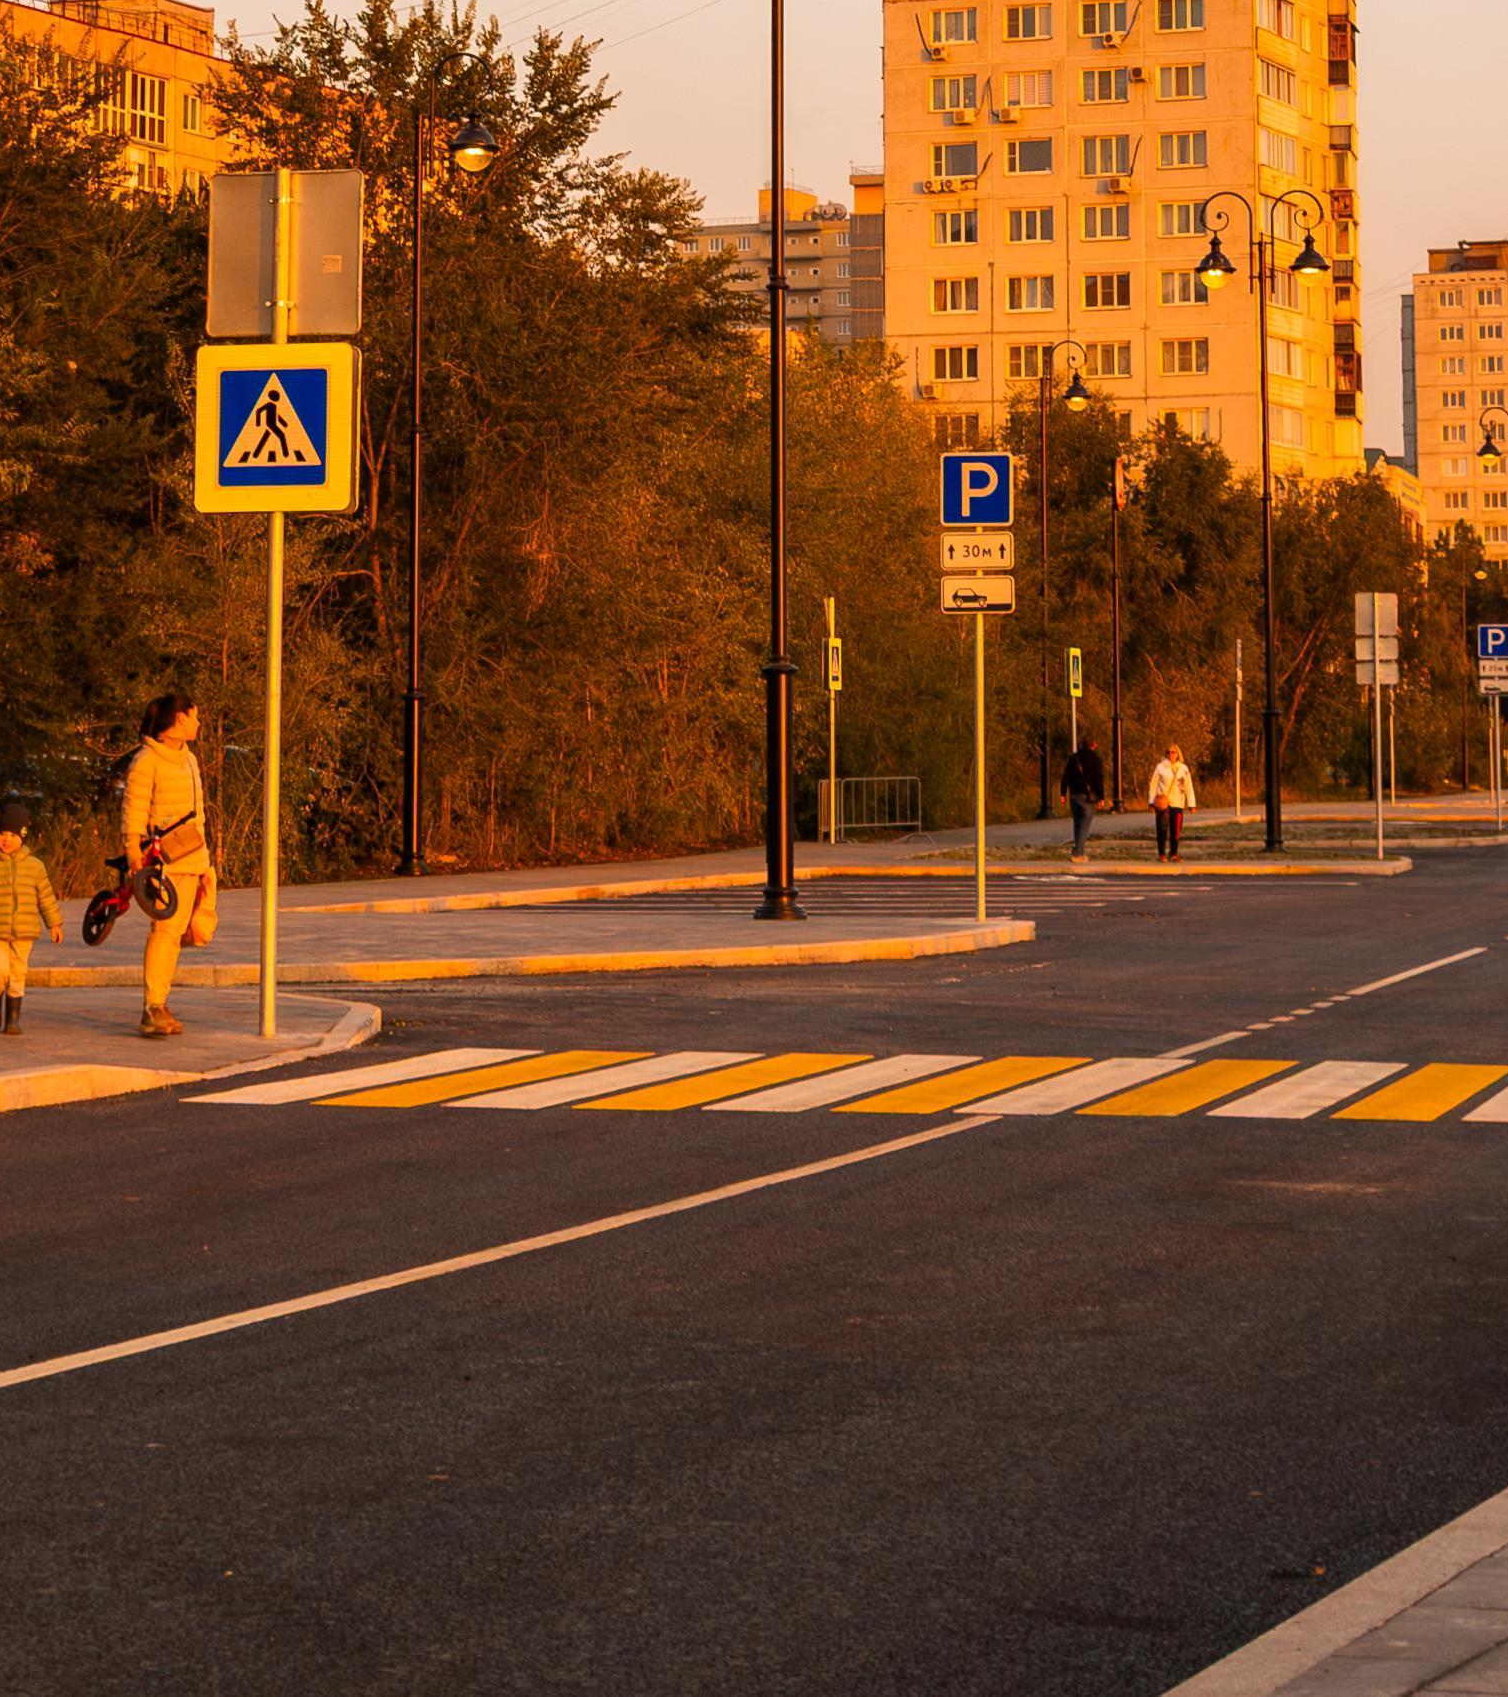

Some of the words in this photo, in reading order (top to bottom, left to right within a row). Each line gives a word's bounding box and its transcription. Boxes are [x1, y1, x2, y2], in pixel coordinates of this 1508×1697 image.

[961, 462, 998, 517] P
[962, 545, 993, 558] 30м
[1487, 628, 1505, 655] P
